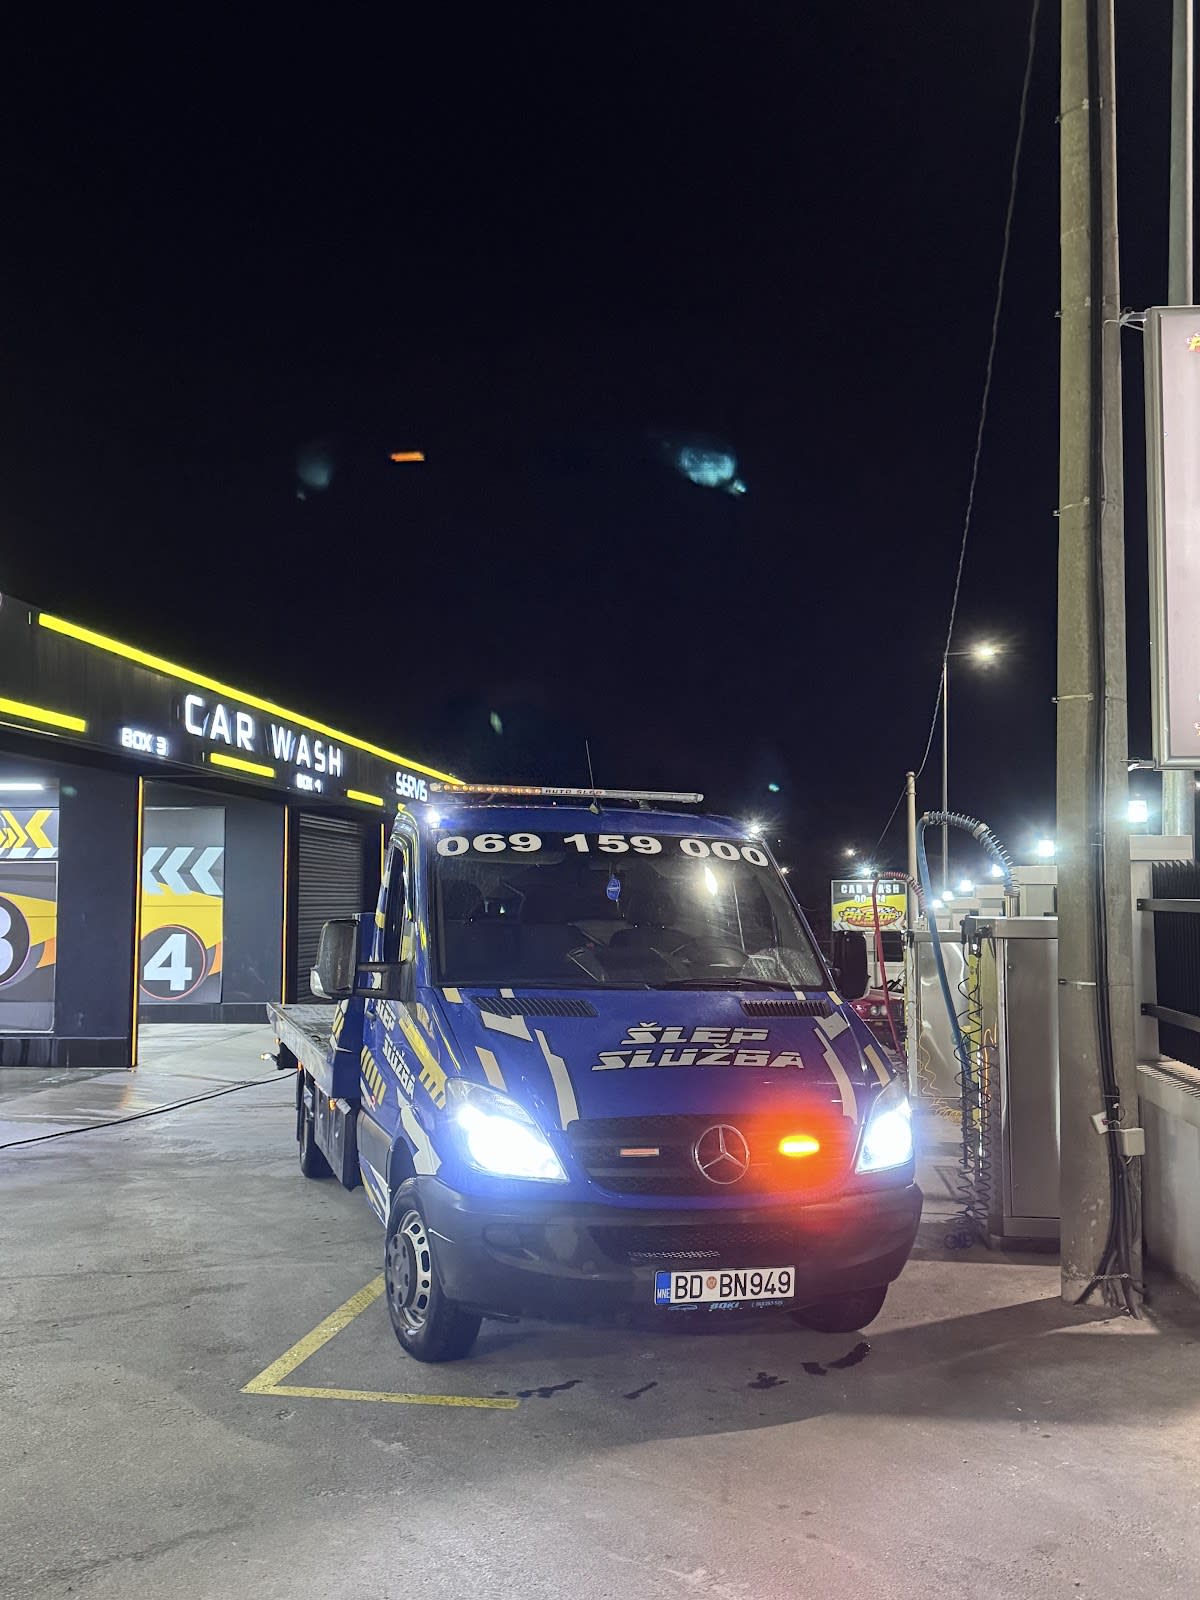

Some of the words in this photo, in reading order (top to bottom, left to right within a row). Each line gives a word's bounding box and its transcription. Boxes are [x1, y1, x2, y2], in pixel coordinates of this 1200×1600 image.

[121, 727, 153, 754] BOX
[156, 736, 168, 757] 3
[185, 694, 254, 752] CAR
[271, 724, 343, 778] WASH
[296, 773, 313, 791] BOX
[314, 779, 322, 793] 4
[396, 771, 428, 802] SERVIS
[436, 833, 543, 856] 069
[564, 833, 662, 854] 159
[680, 838, 769, 867] 000
[841, 884, 863, 894] CAR
[865, 911, 896, 921] SOP
[143, 934, 192, 991] 4
[620, 1022, 769, 1045] ŠLEP
[591, 1043, 805, 1071] SLUŽBA
[657, 1288, 671, 1299] MNE
[674, 1275, 703, 1299] BD
[719, 1271, 791, 1298] BN949
